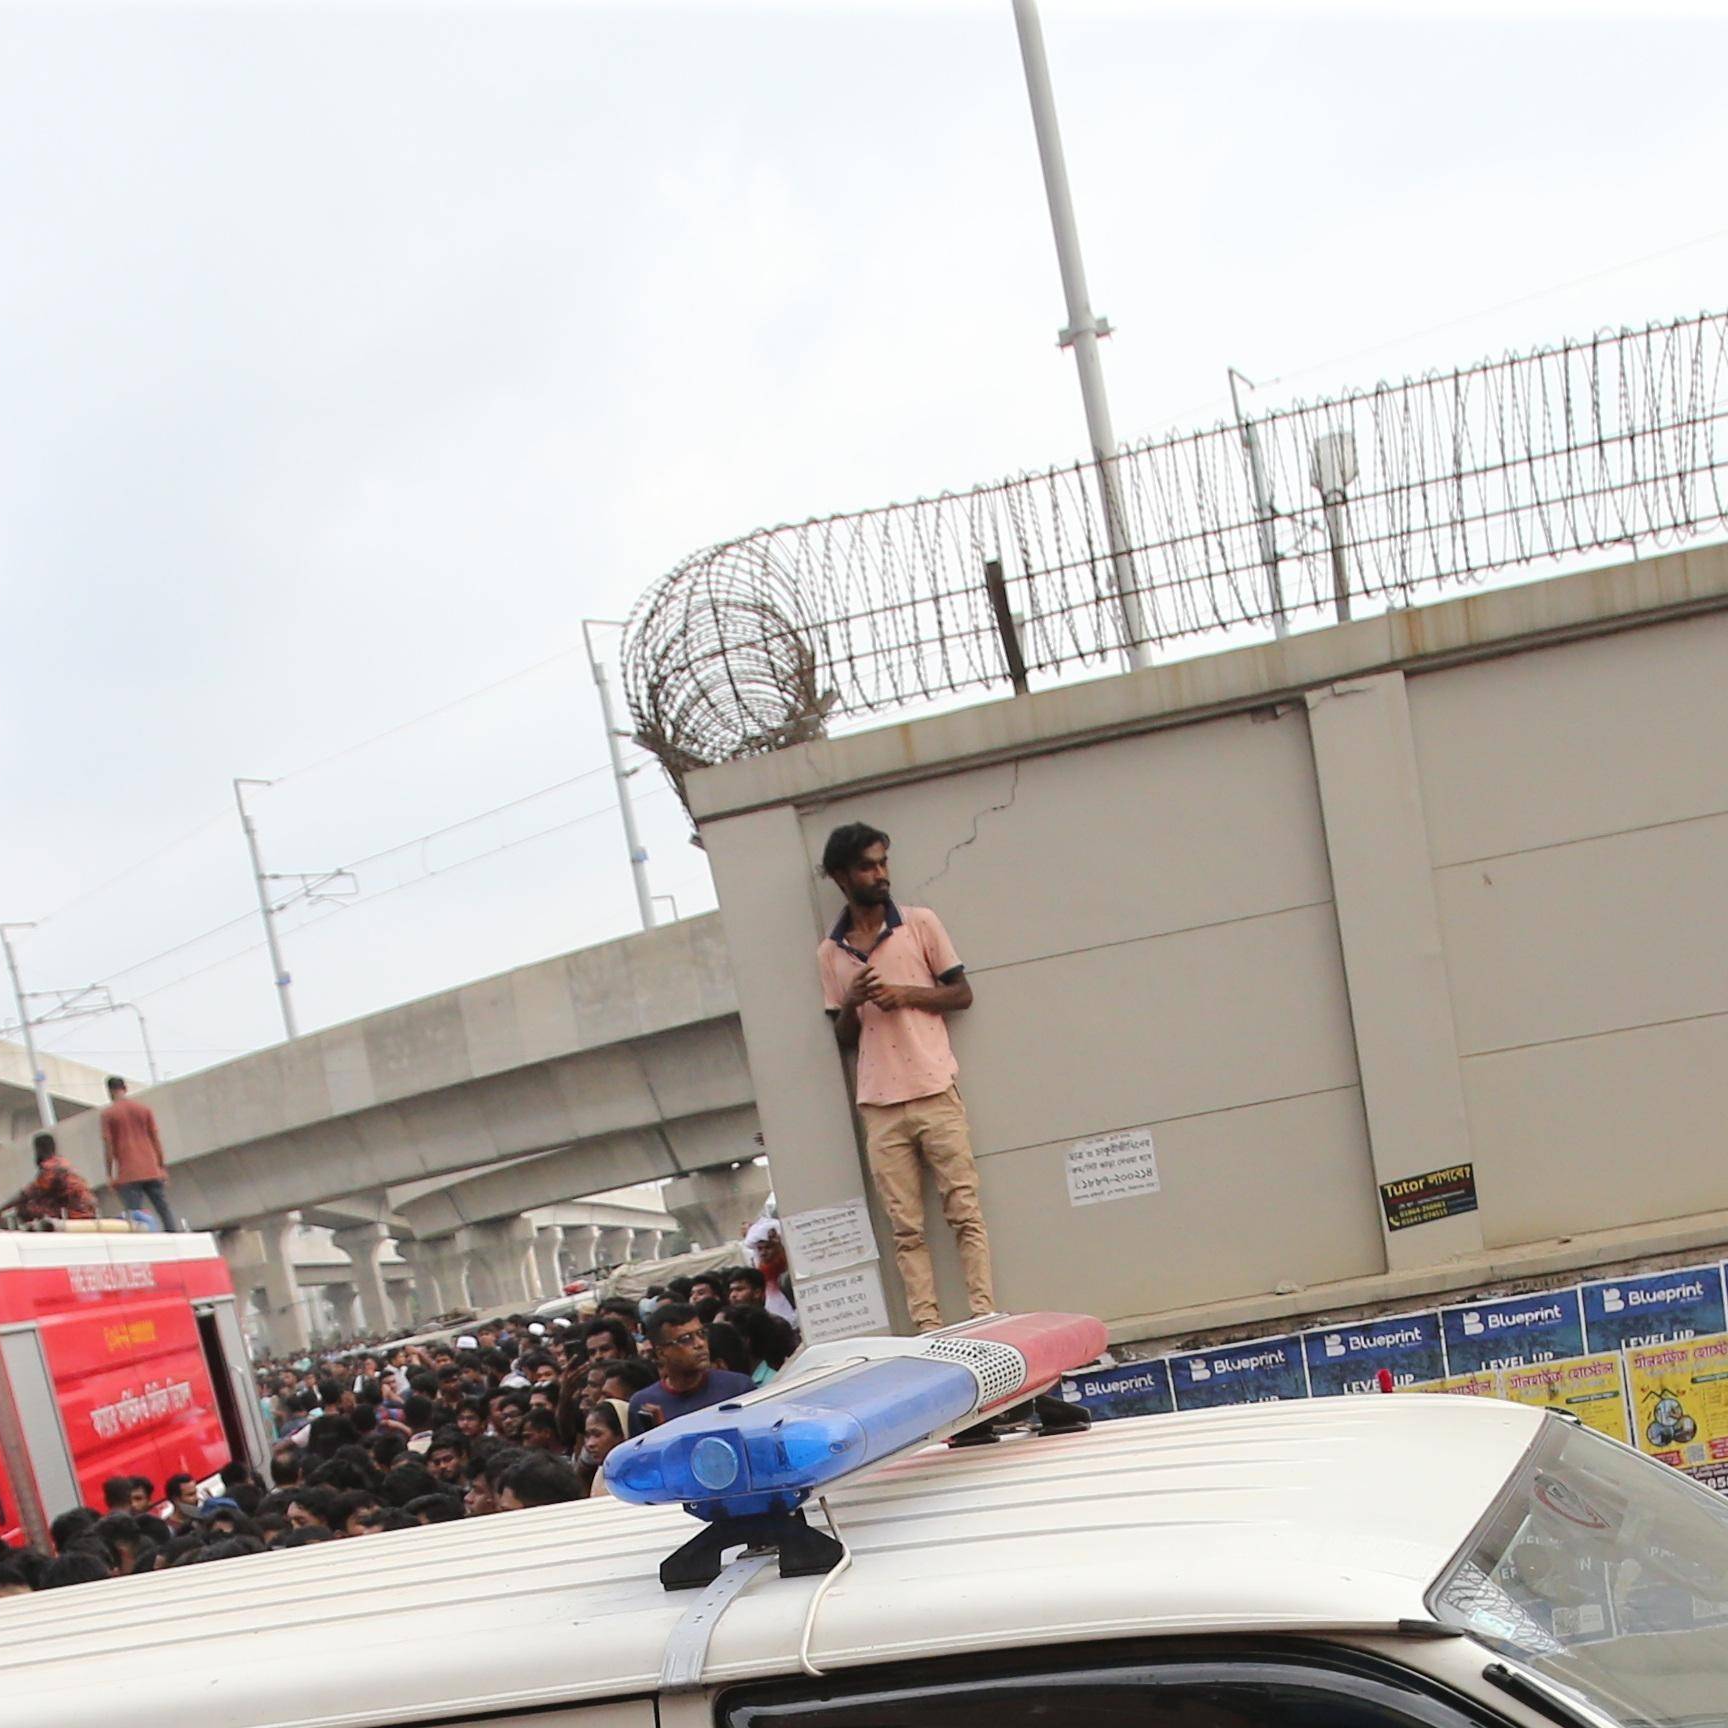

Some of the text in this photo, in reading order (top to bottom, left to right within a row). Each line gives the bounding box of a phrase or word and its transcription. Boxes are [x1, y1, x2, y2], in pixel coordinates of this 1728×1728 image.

[1384, 1178, 1425, 1198] Tutor
[1628, 1282, 1703, 1306] Blueprint
[1488, 1305, 1562, 1330] Blueprint
[1349, 1327, 1422, 1352] Blueprint
[1214, 1350, 1286, 1375] Blueprint
[1084, 1373, 1155, 1397] Blueprint
[1343, 1374, 1415, 1395] LEVE UP
